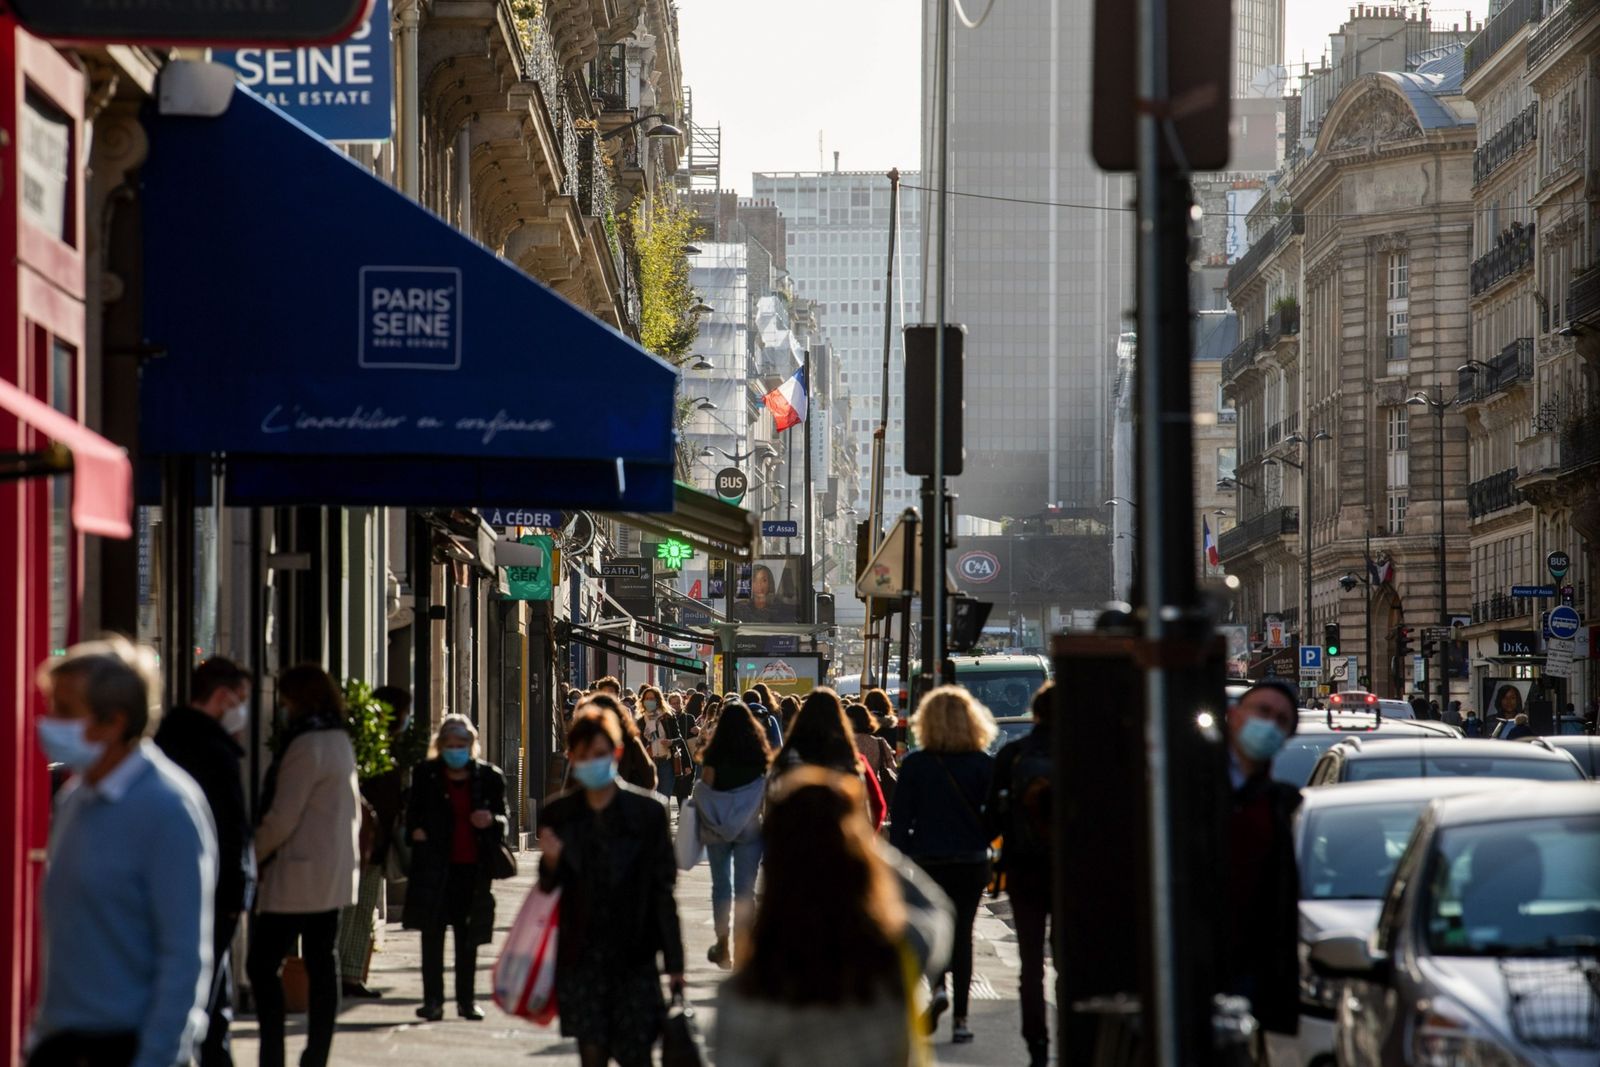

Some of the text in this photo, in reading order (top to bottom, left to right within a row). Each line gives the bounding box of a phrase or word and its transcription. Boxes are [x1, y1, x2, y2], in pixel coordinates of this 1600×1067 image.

[235, 45, 373, 86] SEINE
[299, 91, 370, 105] ESTATE
[372, 287, 451, 313] PARIS
[373, 312, 450, 337] SEINE
[720, 476, 743, 489] BUS
[492, 508, 552, 527] À CÉDER
[776, 525, 795, 533] Assas
[965, 560, 992, 574] C&A
[1550, 557, 1567, 566] BUS
[511, 571, 538, 582] GER
[602, 567, 635, 575] GATHA
[1306, 650, 1316, 664] P
